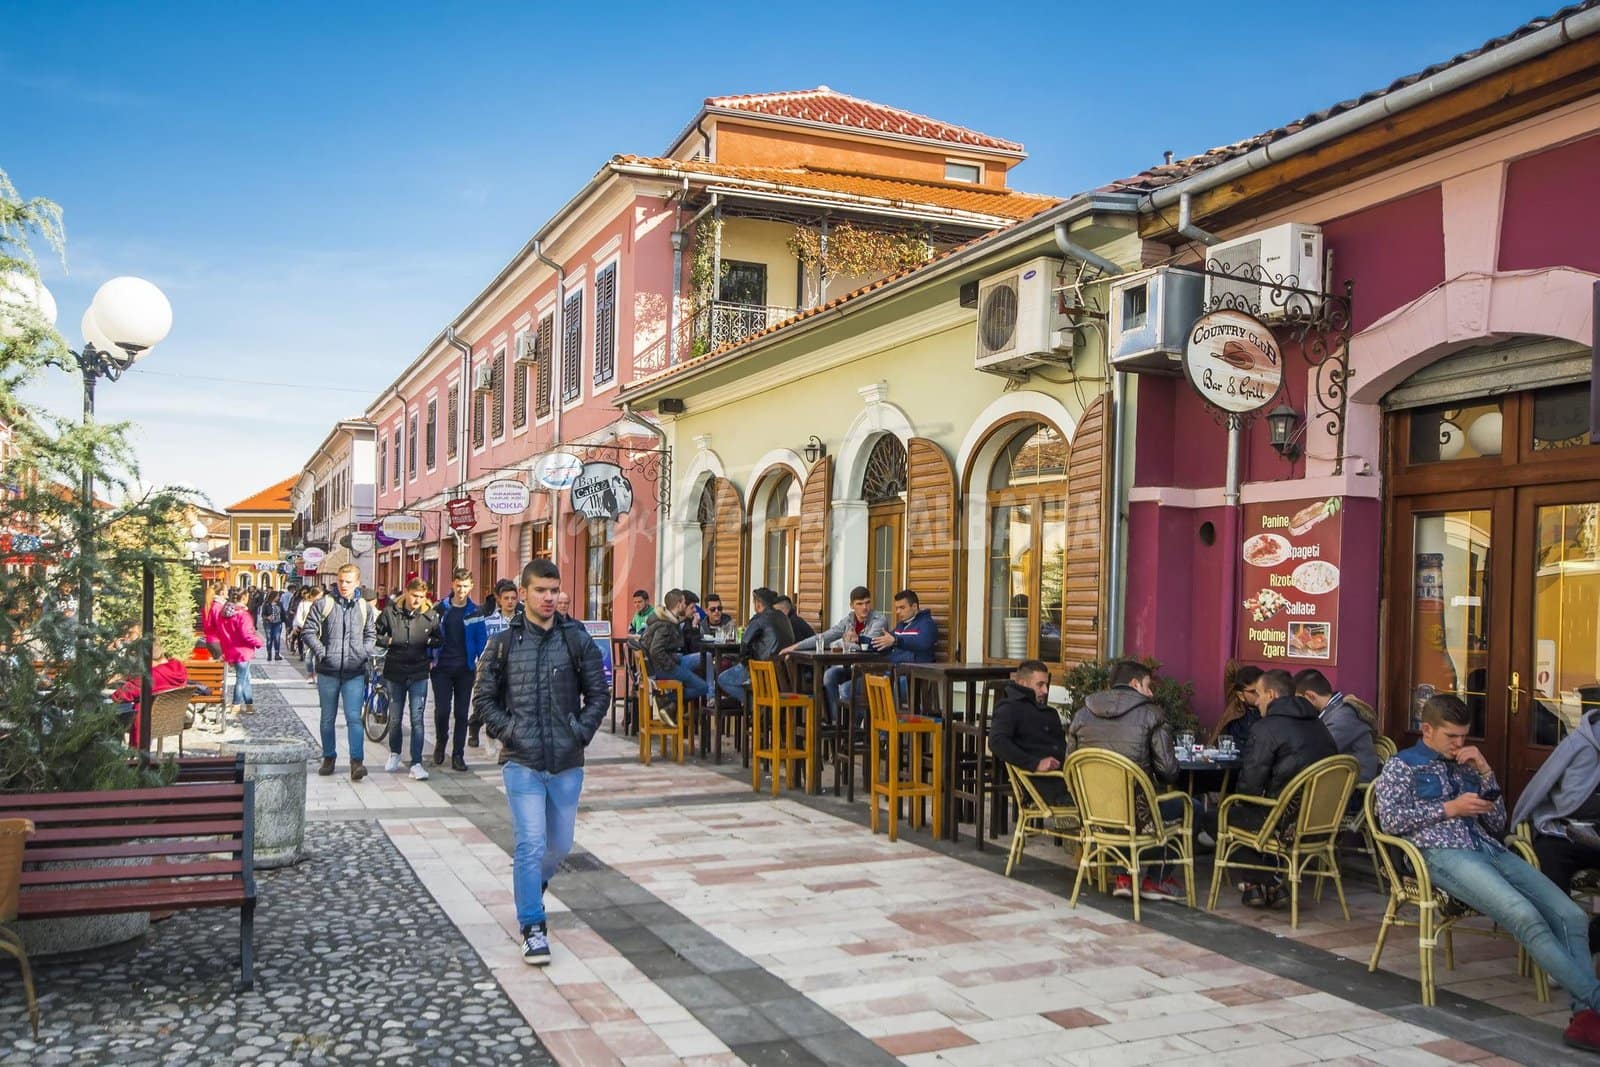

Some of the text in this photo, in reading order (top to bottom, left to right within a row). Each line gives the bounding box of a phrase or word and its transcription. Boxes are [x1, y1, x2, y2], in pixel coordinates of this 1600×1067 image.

[1193, 325, 1246, 345] COUNTRY
[1203, 368, 1266, 400] Bar & Grill
[577, 475, 600, 488] Bar
[1262, 514, 1289, 528] Panine
[1286, 601, 1316, 615] Sallate
[1249, 627, 1286, 642] Prodhime
[1263, 643, 1285, 658] Zgare
